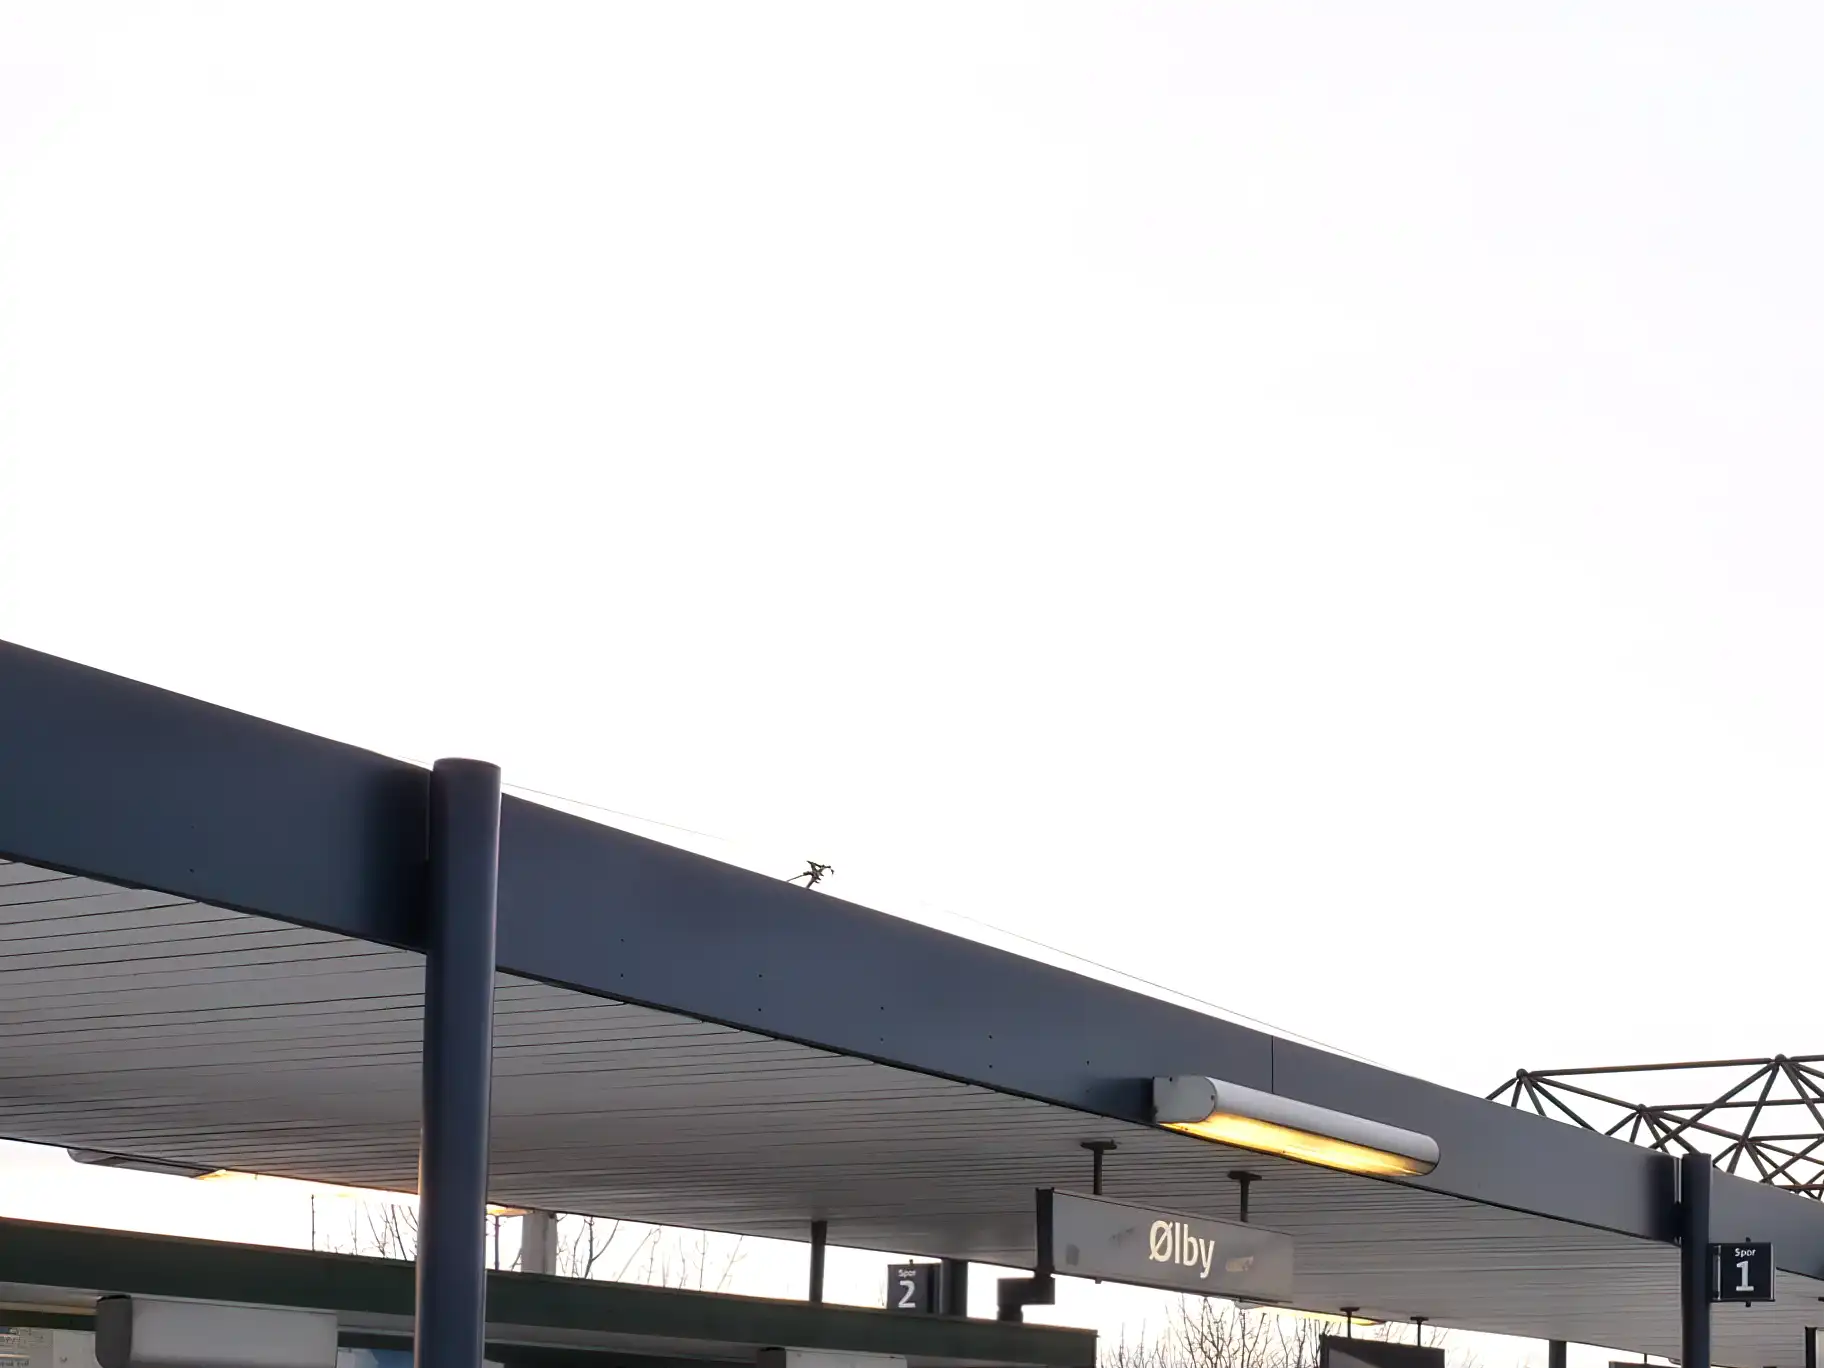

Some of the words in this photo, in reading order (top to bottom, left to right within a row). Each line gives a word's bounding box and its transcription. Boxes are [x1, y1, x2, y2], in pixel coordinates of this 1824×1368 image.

[1149, 1219, 1216, 1280] Ølby
[1734, 1247, 1757, 1258] Spor
[898, 1268, 917, 1278] Spor
[1735, 1260, 1755, 1292] 1
[898, 1279, 916, 1308] 2
